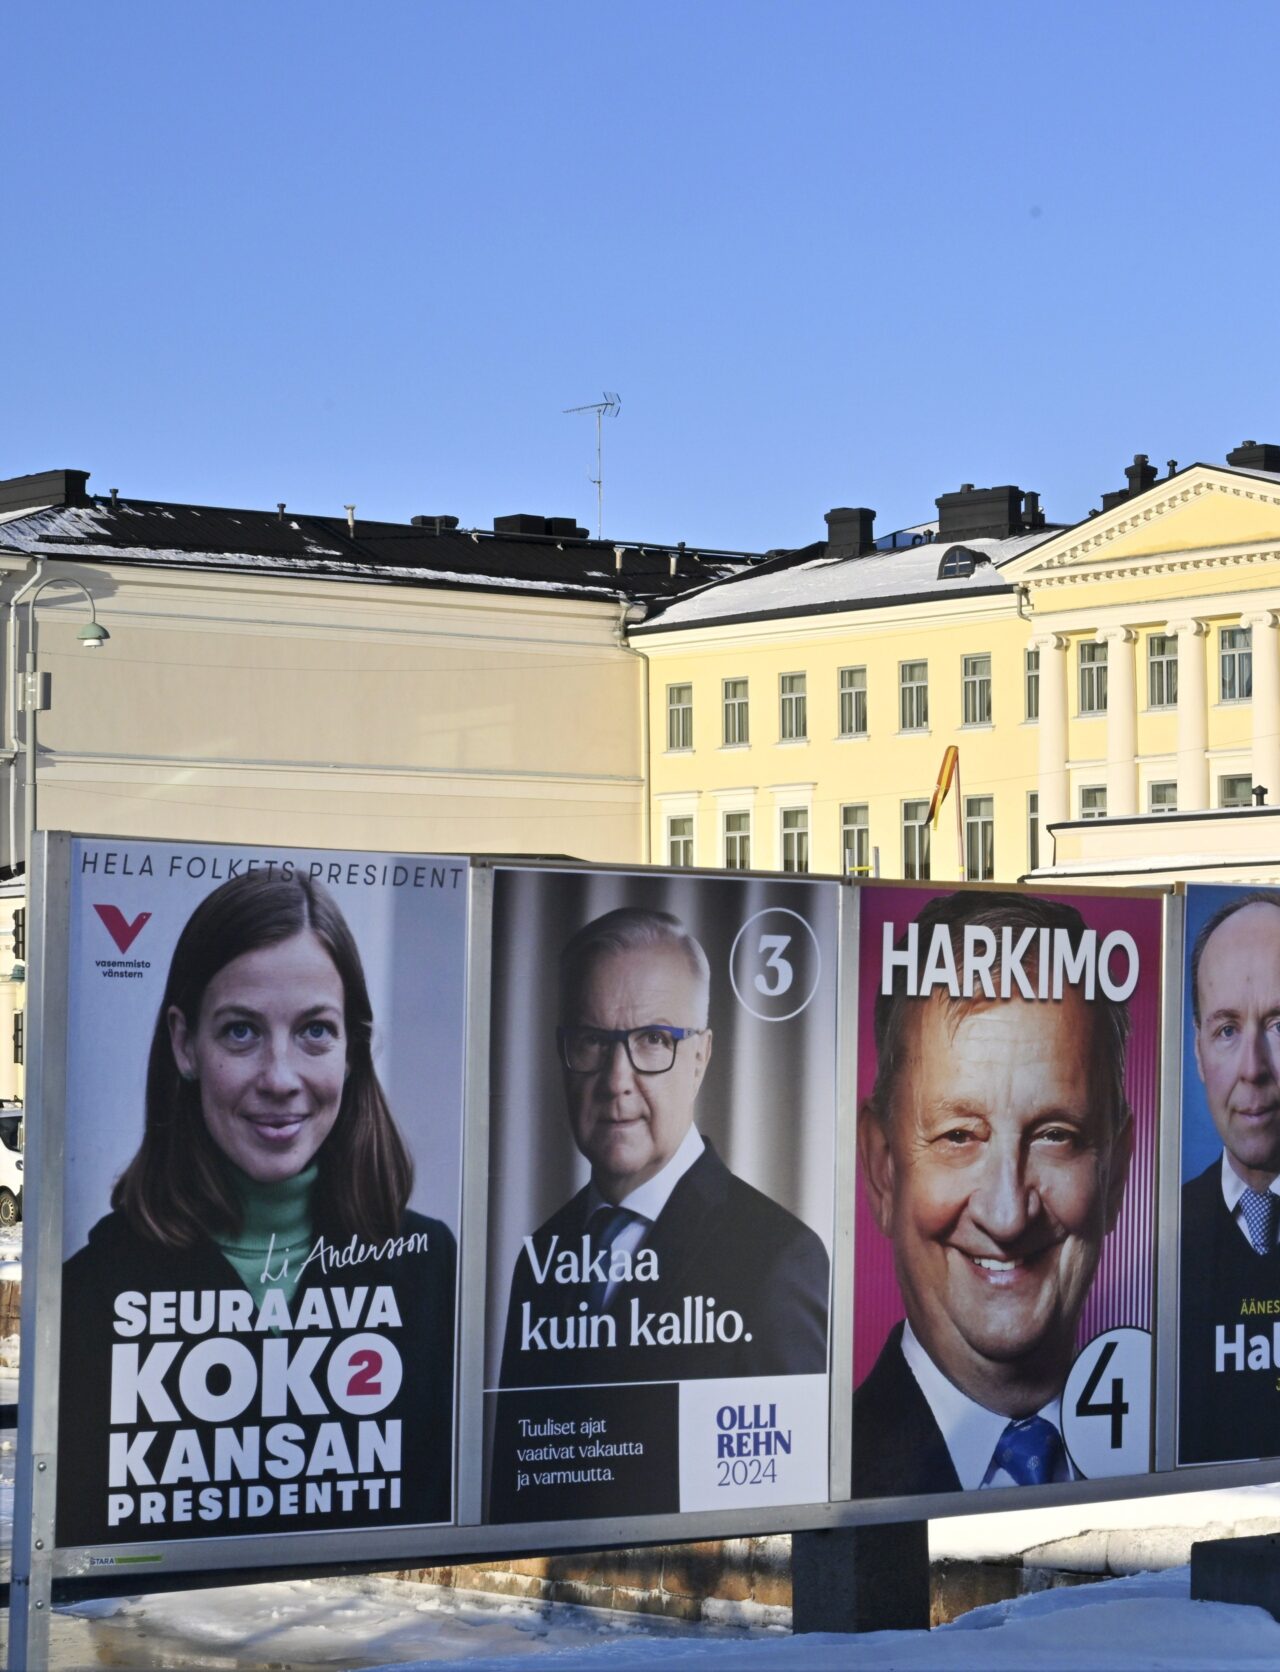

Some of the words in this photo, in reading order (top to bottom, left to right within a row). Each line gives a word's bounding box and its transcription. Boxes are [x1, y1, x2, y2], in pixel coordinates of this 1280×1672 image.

[81, 852, 154, 877] HELA
[169, 856, 296, 882] FOLKETS
[309, 863, 464, 889] PRESIDENT
[95, 960, 151, 969] vasemmisto
[102, 969, 144, 979] vänstern
[753, 934, 794, 997] 3
[881, 921, 1140, 1002] HARKIMO
[294, 1233, 429, 1282] Andersson
[523, 1234, 660, 1285] Vakaa
[112, 1285, 403, 1337] SEURAAVA
[520, 1301, 618, 1351] kuin
[630, 1295, 753, 1347] kallio.
[1075, 1341, 1129, 1449] 4
[518, 1418, 577, 1438] Tuuliset
[580, 1418, 607, 1439] ajat
[716, 1403, 777, 1431] OLLI
[108, 1419, 402, 1488] KANSAN
[517, 1443, 576, 1462] vaativat
[578, 1439, 644, 1459] vakautta
[716, 1430, 792, 1459] REHN
[516, 1470, 531, 1491] ja
[533, 1464, 615, 1485] varmuutta.
[717, 1458, 778, 1487] 2024
[107, 1478, 401, 1527] PRESIDENTTI
